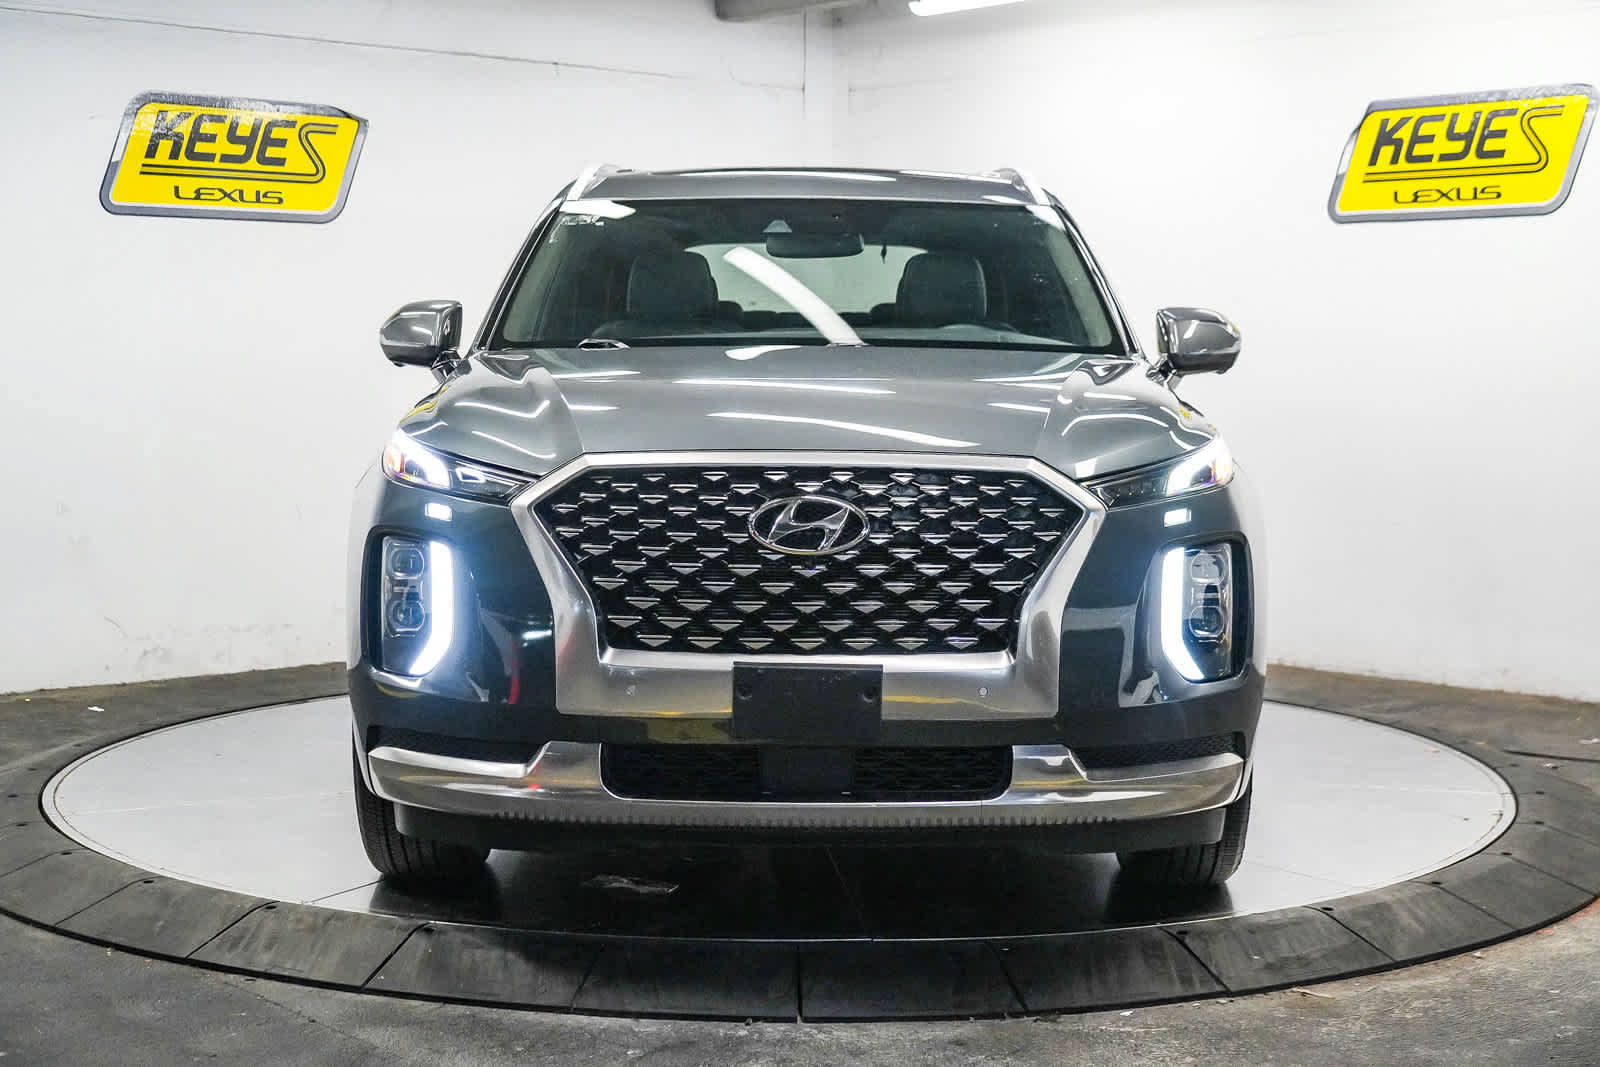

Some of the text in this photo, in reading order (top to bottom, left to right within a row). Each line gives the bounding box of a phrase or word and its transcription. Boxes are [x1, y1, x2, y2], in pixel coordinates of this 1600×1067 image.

[140, 109, 339, 184] KEYES
[1363, 105, 1566, 182] KEYES
[173, 185, 284, 205] LEXUS
[1393, 185, 1502, 204] LEXUS
